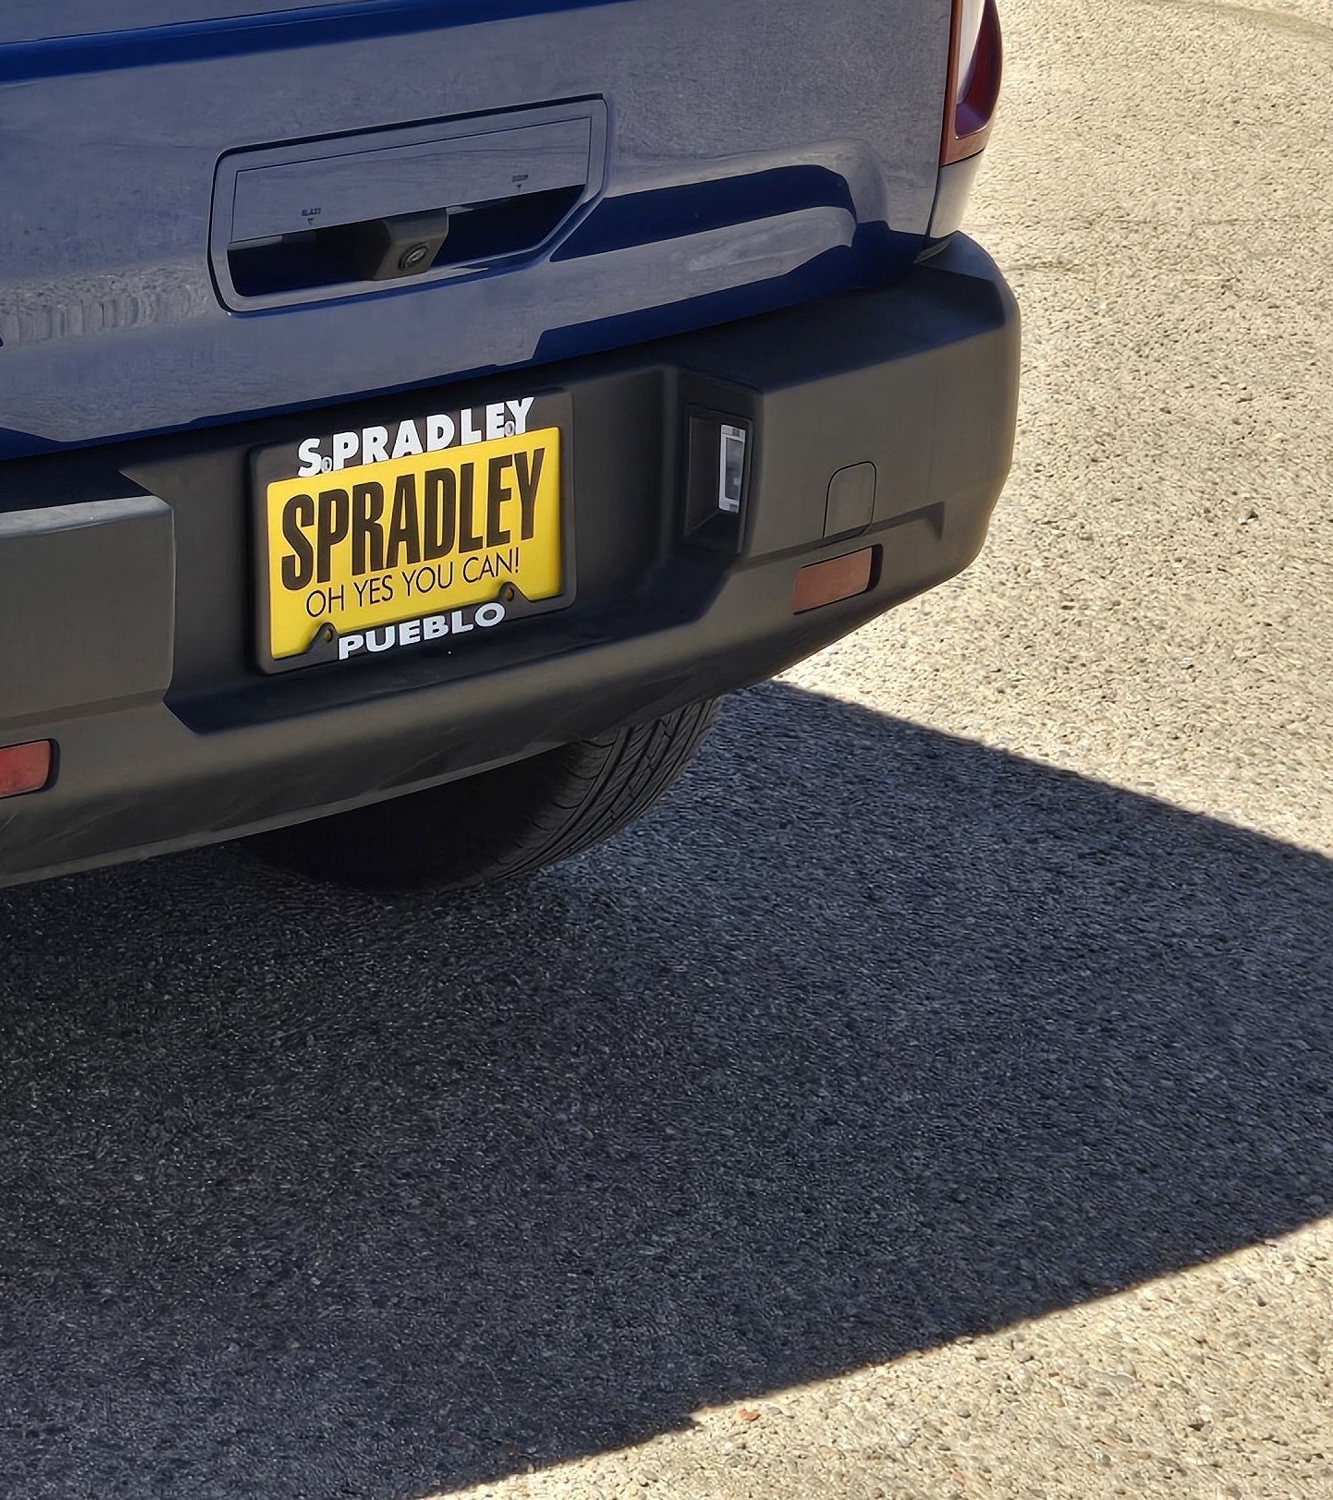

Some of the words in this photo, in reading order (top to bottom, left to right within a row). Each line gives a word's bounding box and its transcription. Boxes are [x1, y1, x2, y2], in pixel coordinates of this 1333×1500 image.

[297, 396, 535, 478] SPRADLEY
[281, 447, 546, 591] SPRADLEY
[306, 589, 345, 618] OH
[353, 574, 394, 606] YES
[401, 561, 454, 598] YOU
[462, 546, 520, 584] CAN!
[338, 601, 506, 660] PUEBLO
